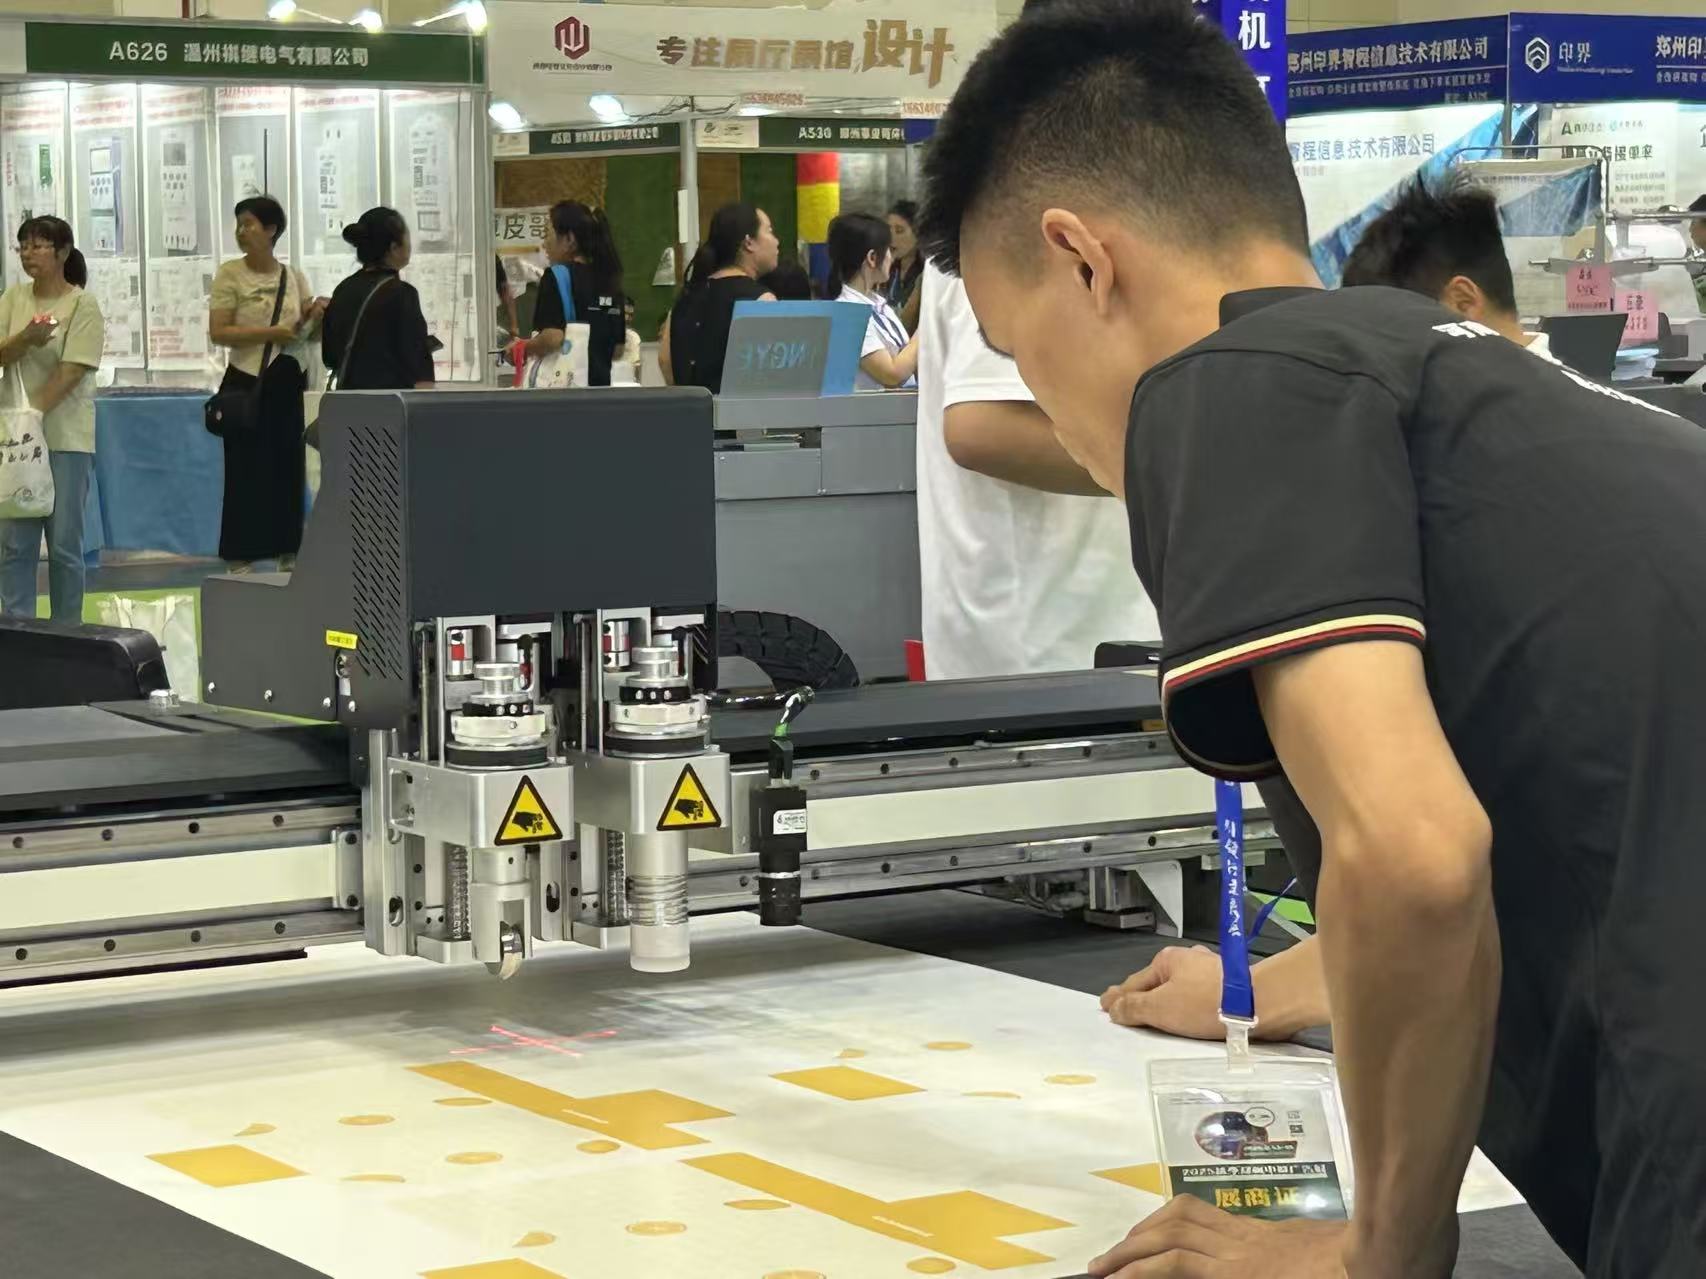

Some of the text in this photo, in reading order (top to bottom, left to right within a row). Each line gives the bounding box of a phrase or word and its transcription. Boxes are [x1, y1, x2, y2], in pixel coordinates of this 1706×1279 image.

[109, 41, 168, 61] A626
[1558, 42, 1592, 63] 印界
[1655, 34, 1706, 60] 郑州印
[494, 211, 549, 240] 皮哥
